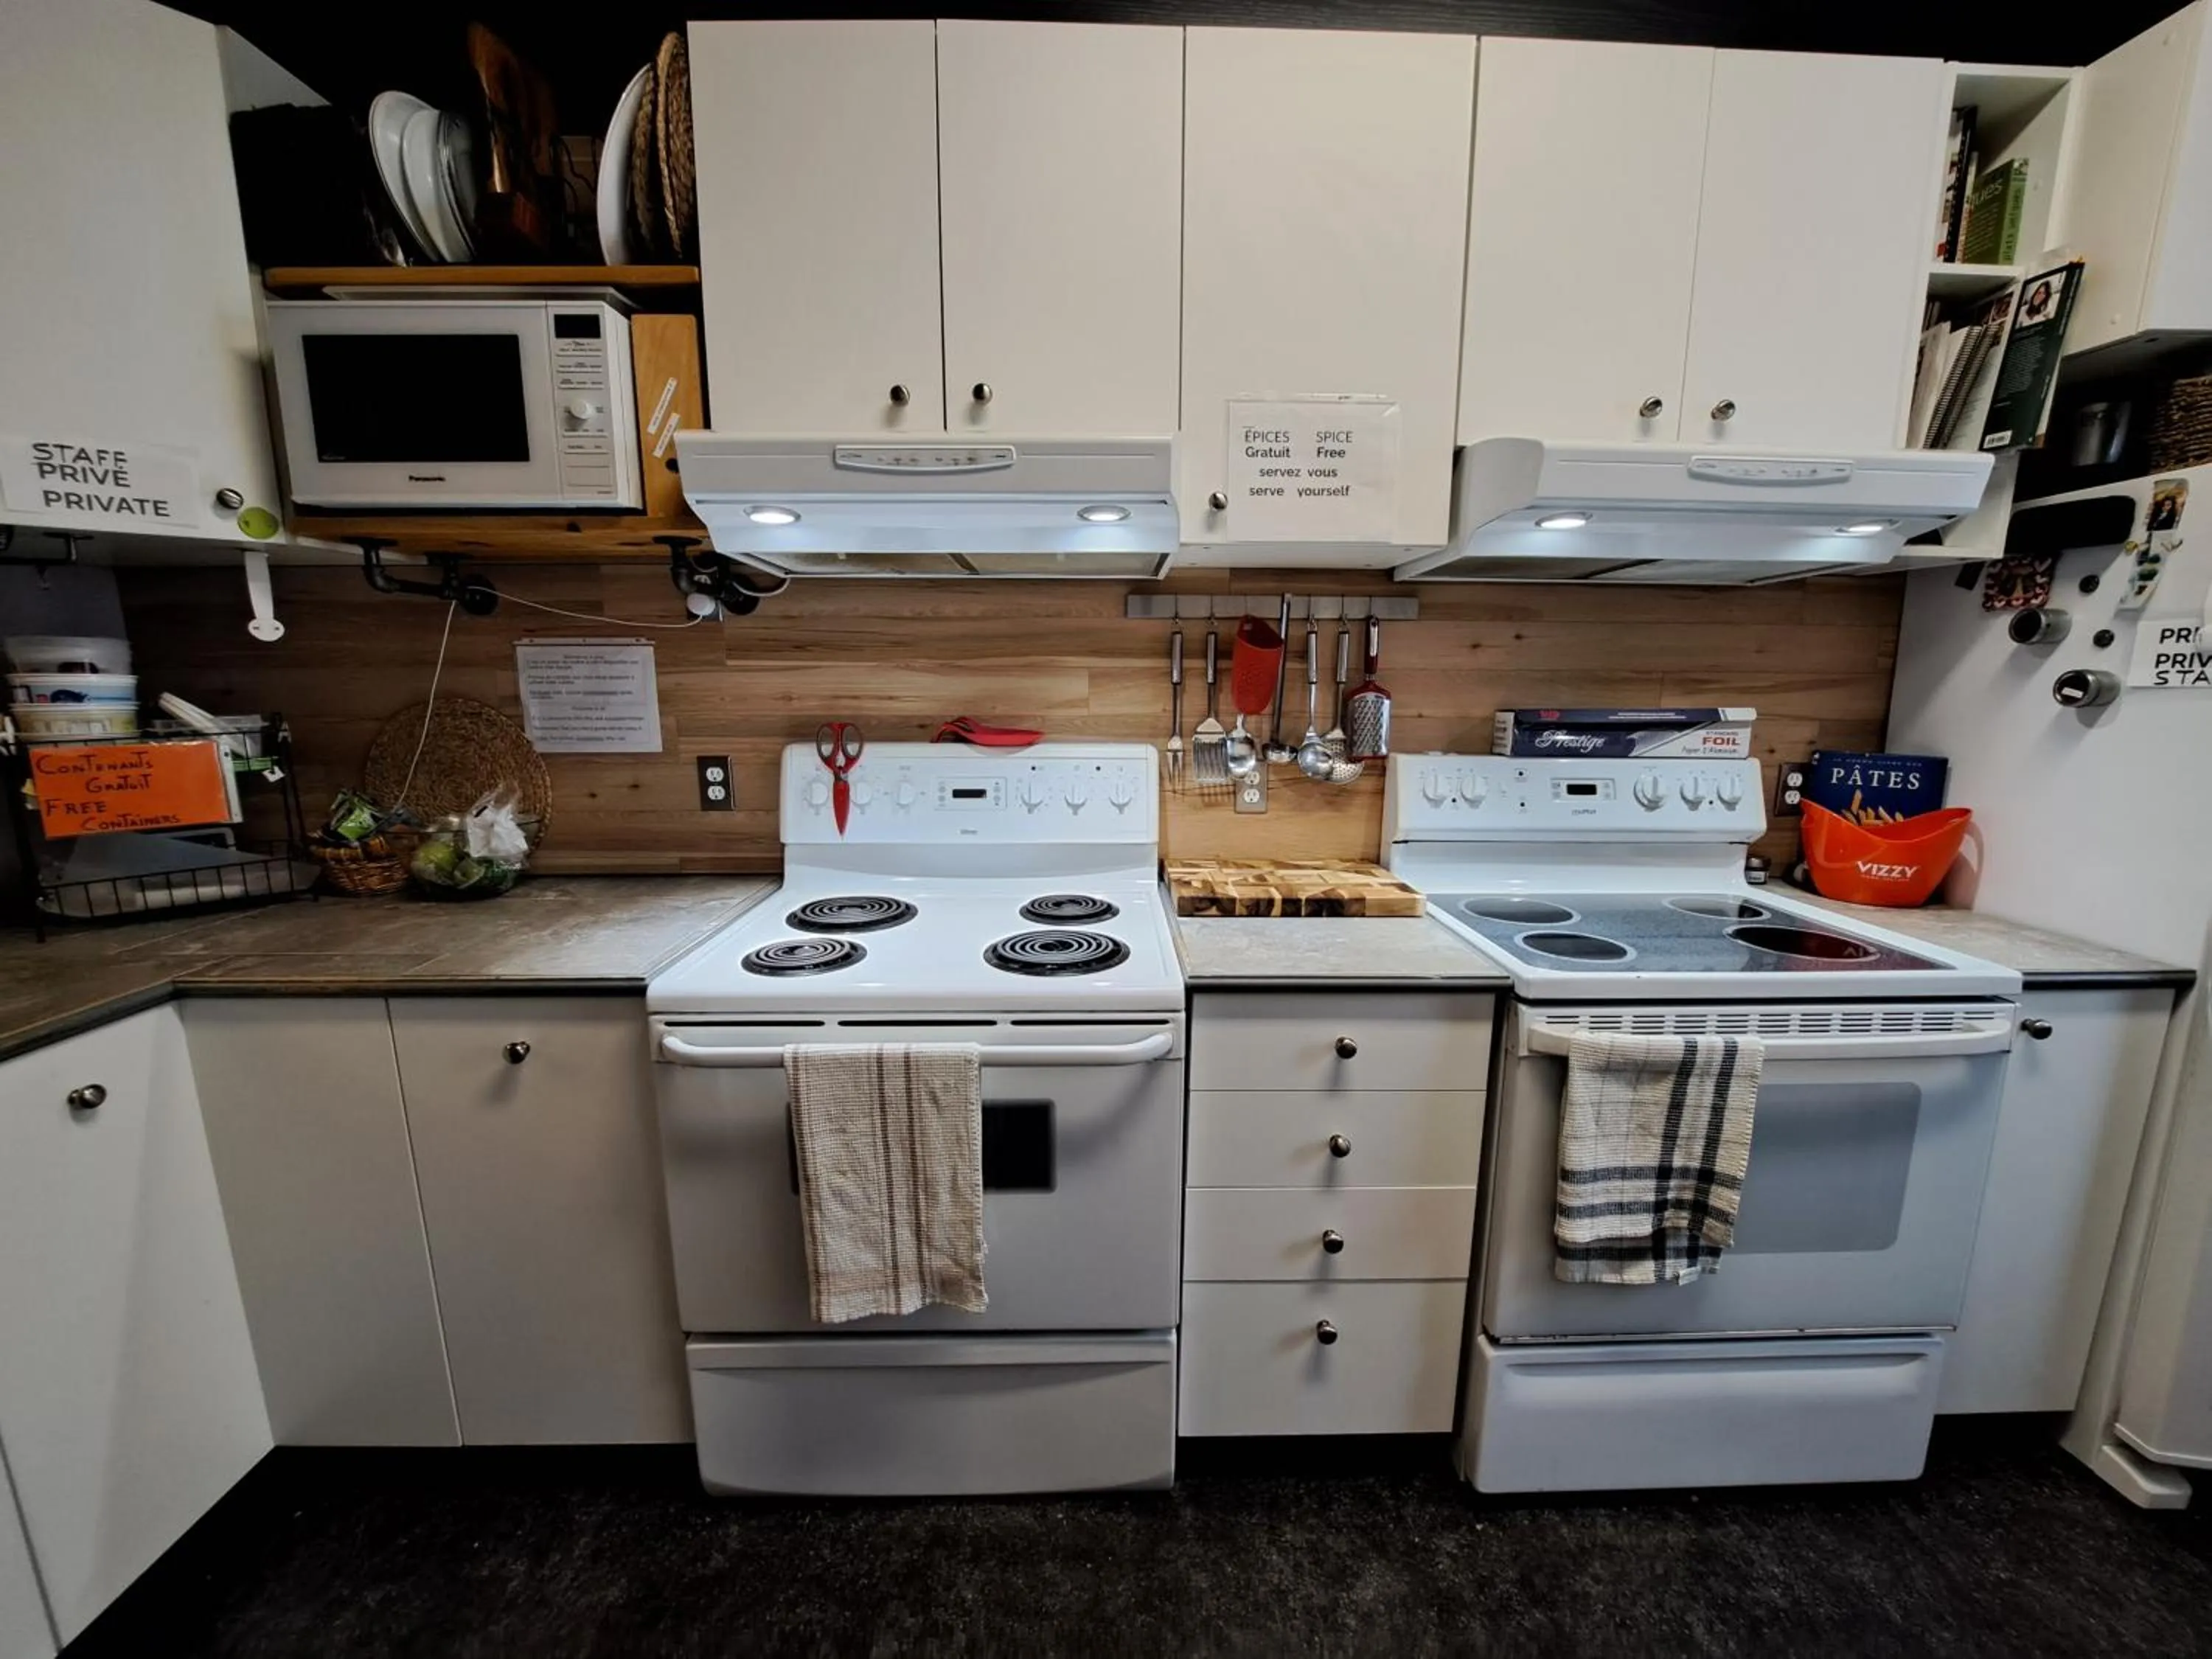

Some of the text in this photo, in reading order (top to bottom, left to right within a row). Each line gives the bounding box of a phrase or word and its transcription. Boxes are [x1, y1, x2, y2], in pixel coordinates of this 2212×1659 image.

[1244, 427, 1353, 443] ÉPICES SPICE
[1245, 446, 1346, 458] Gratuit Free
[1259, 468, 1338, 478] servez vous
[1249, 485, 1351, 498] serve yourself
[43, 490, 170, 516] PRIVATE
[2159, 626, 2200, 644] PRI
[1534, 730, 1606, 753] Prestige
[1703, 737, 1741, 745] FOIL
[1831, 764, 1921, 790] PÂTES
[44, 799, 107, 818] FREE
[1857, 860, 1920, 878] VIZZY
